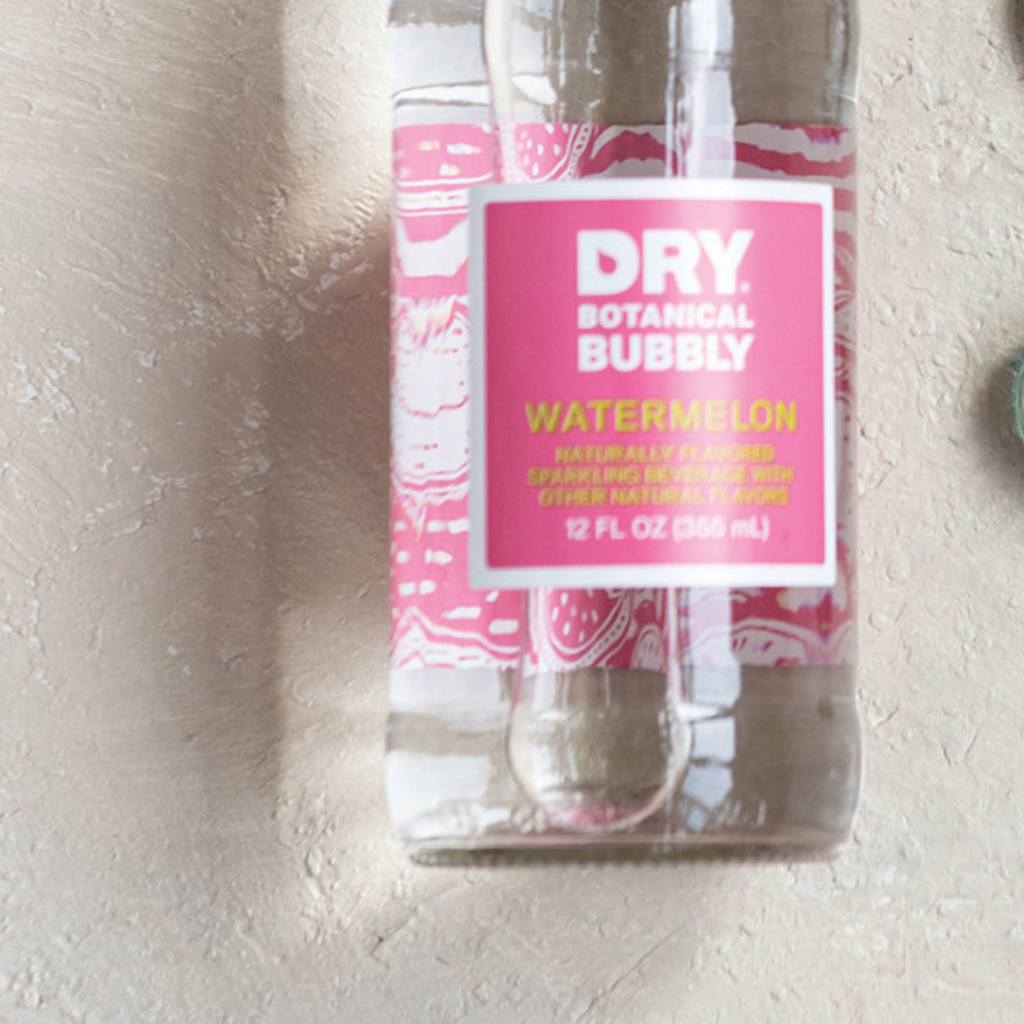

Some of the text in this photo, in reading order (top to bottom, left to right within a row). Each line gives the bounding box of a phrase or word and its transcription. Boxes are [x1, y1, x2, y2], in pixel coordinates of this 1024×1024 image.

[577, 303, 755, 329] BOTANICAL
[577, 333, 755, 372] BUBBLY
[524, 399, 798, 434] WATERMELON
[555, 443, 776, 464] NATURALLY FLAVORED
[527, 466, 795, 487] SPARKLING BEVERAGE WITH
[538, 486, 790, 508] OTHER NATURAL FLAVORS
[565, 517, 590, 540] 12
[595, 517, 625, 540] FL
[631, 516, 668, 540] OZ
